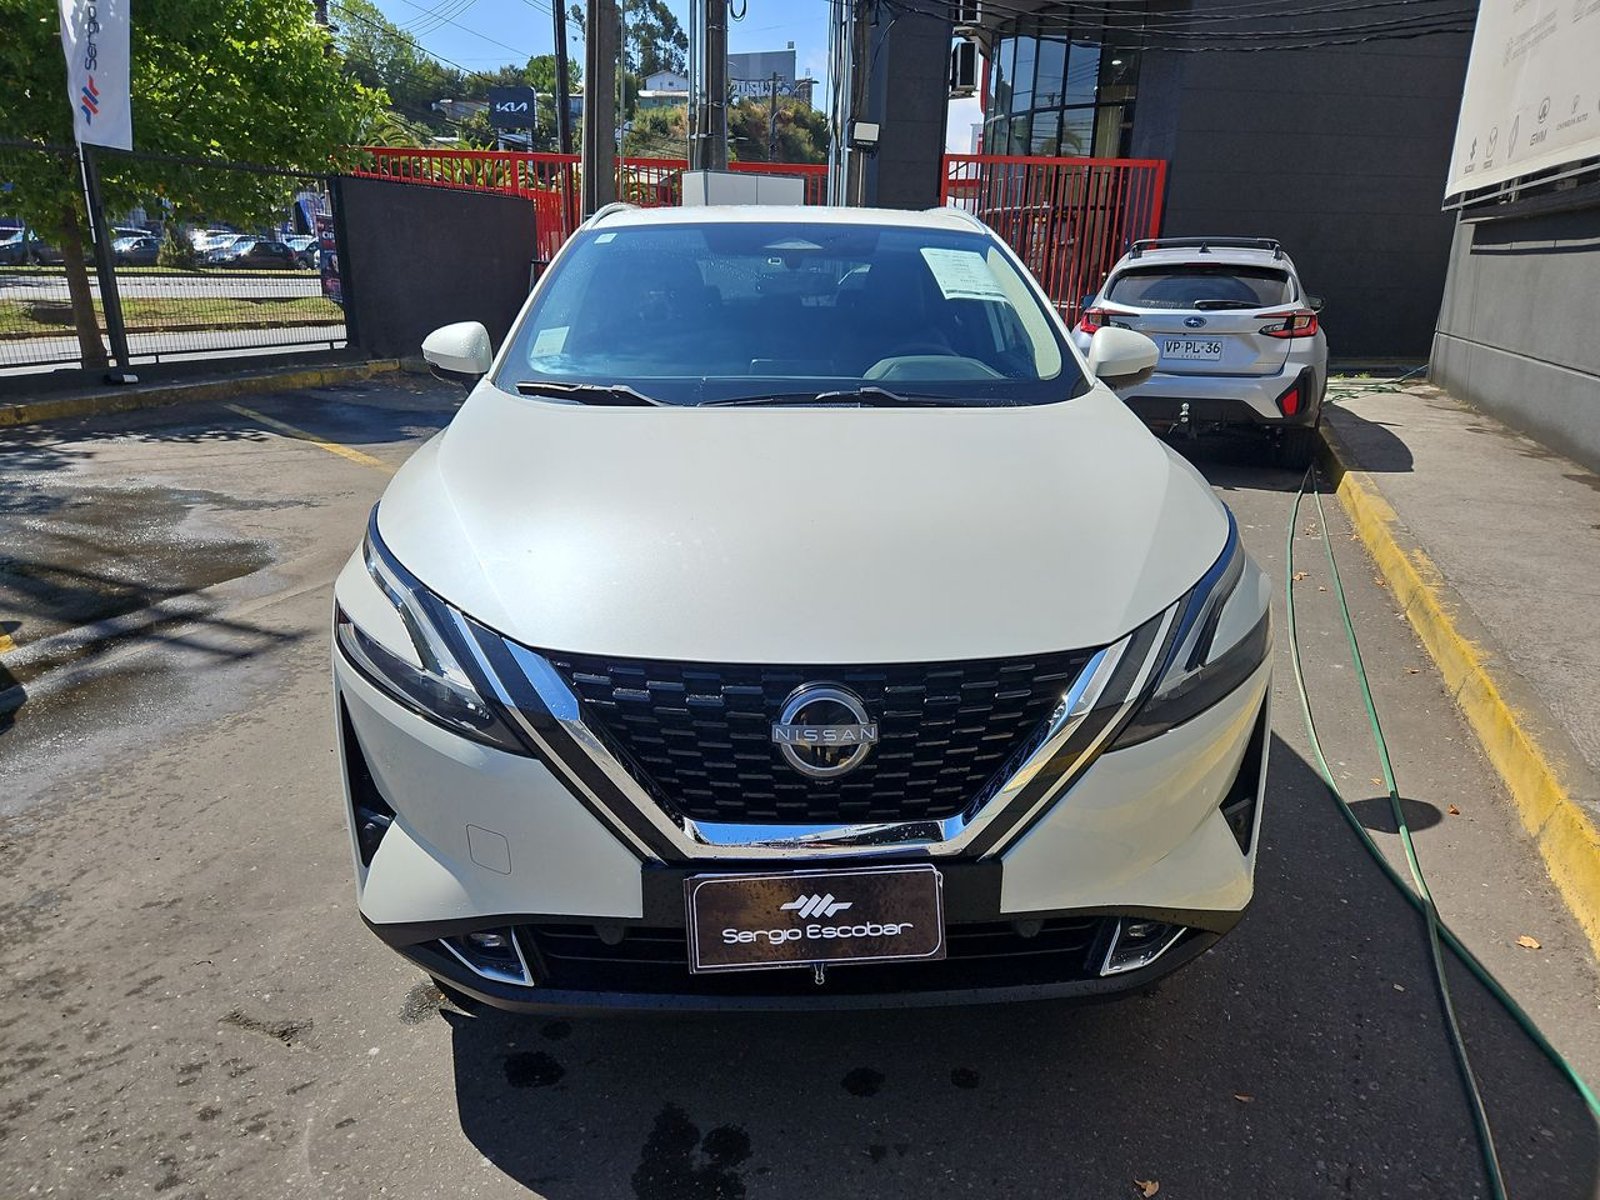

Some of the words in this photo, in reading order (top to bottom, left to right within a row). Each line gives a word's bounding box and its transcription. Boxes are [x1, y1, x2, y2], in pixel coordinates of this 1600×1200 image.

[775, 726, 876, 742] NISSAN
[721, 927, 802, 945] Sergio
[806, 921, 914, 940] Escobar
